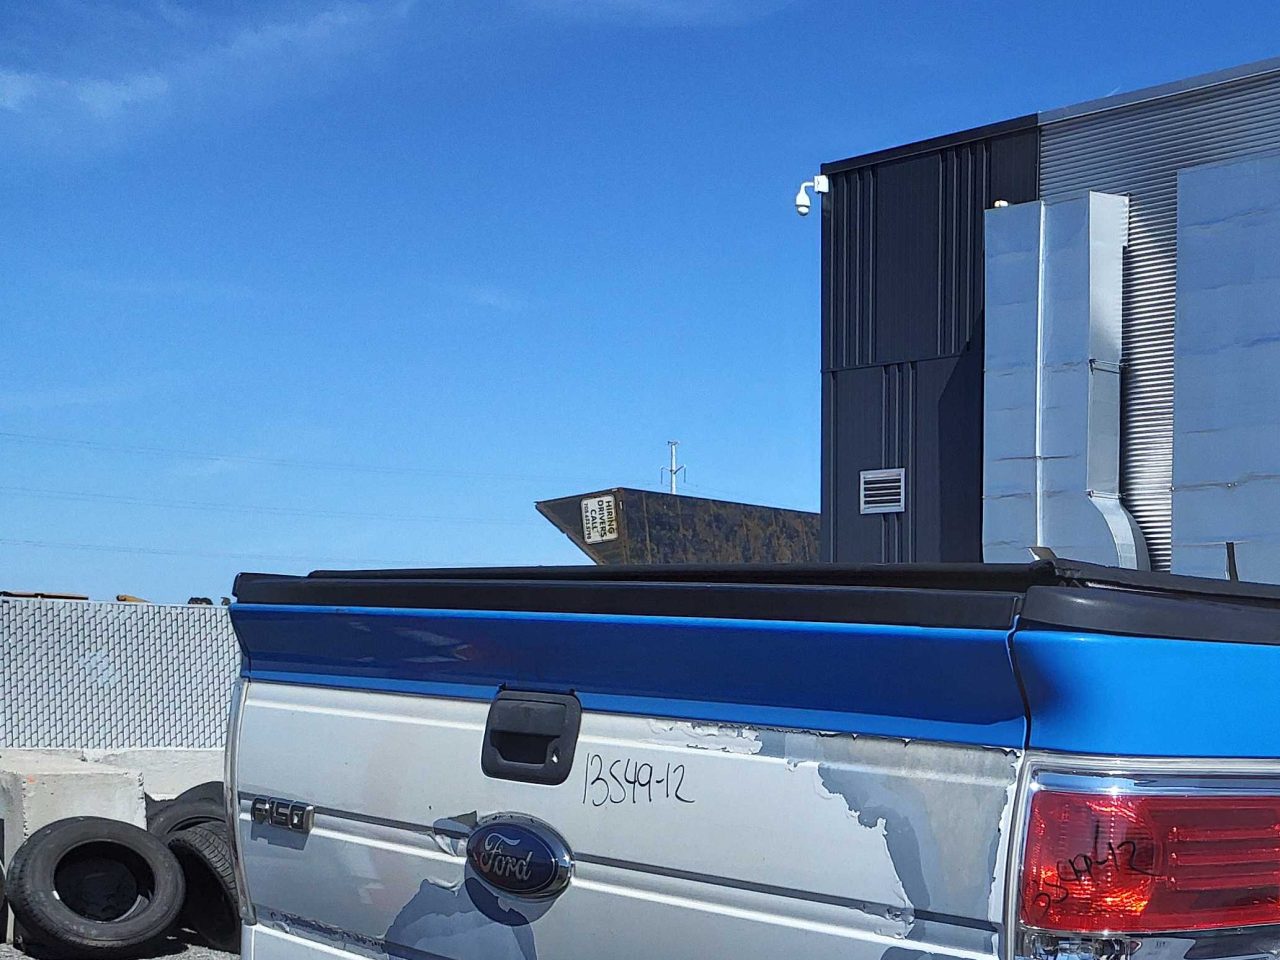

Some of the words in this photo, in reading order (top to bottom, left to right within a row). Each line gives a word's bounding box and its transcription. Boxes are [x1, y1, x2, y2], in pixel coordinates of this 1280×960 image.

[590, 509, 598, 531] CALL
[597, 500, 608, 538] DRIVERS
[605, 500, 615, 535] HIRING
[473, 832, 534, 881] Ford
